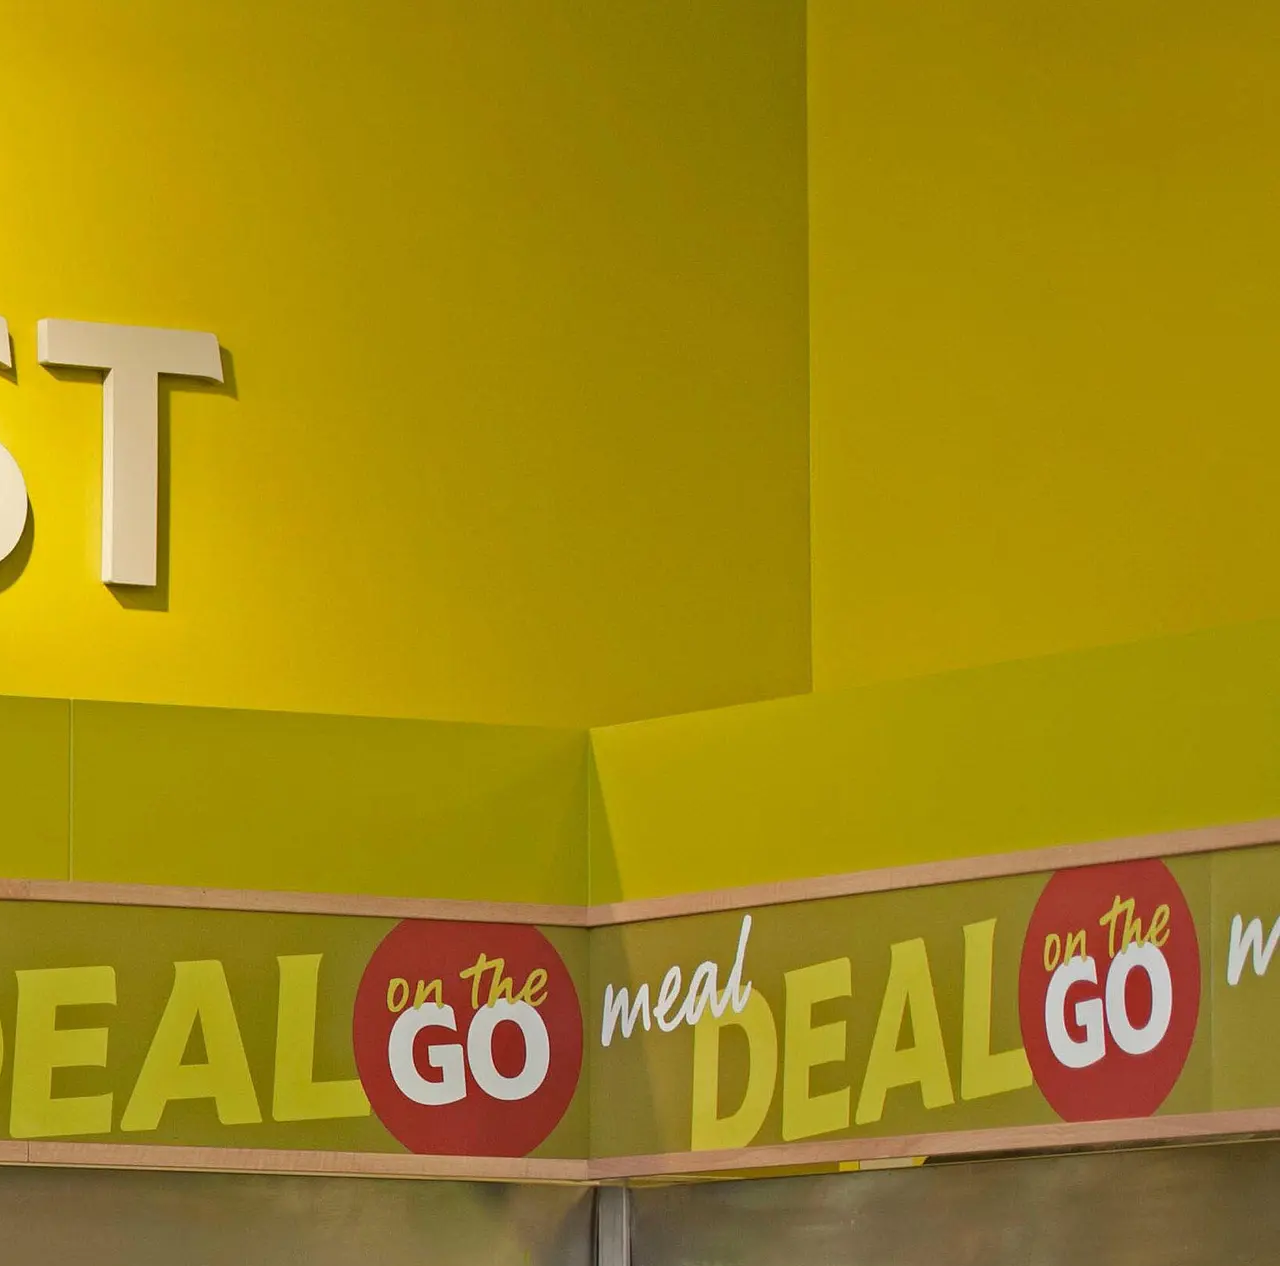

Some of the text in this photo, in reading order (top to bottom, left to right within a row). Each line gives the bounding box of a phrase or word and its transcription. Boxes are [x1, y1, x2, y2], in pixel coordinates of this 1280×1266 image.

[387, 952, 548, 1013] on the
[601, 914, 752, 1047] meal
[1044, 929, 1088, 972] on
[1100, 895, 1171, 950] the
[387, 996, 551, 1107] GO
[691, 917, 1034, 1152] DEAL
[1045, 941, 1173, 1069] GO
